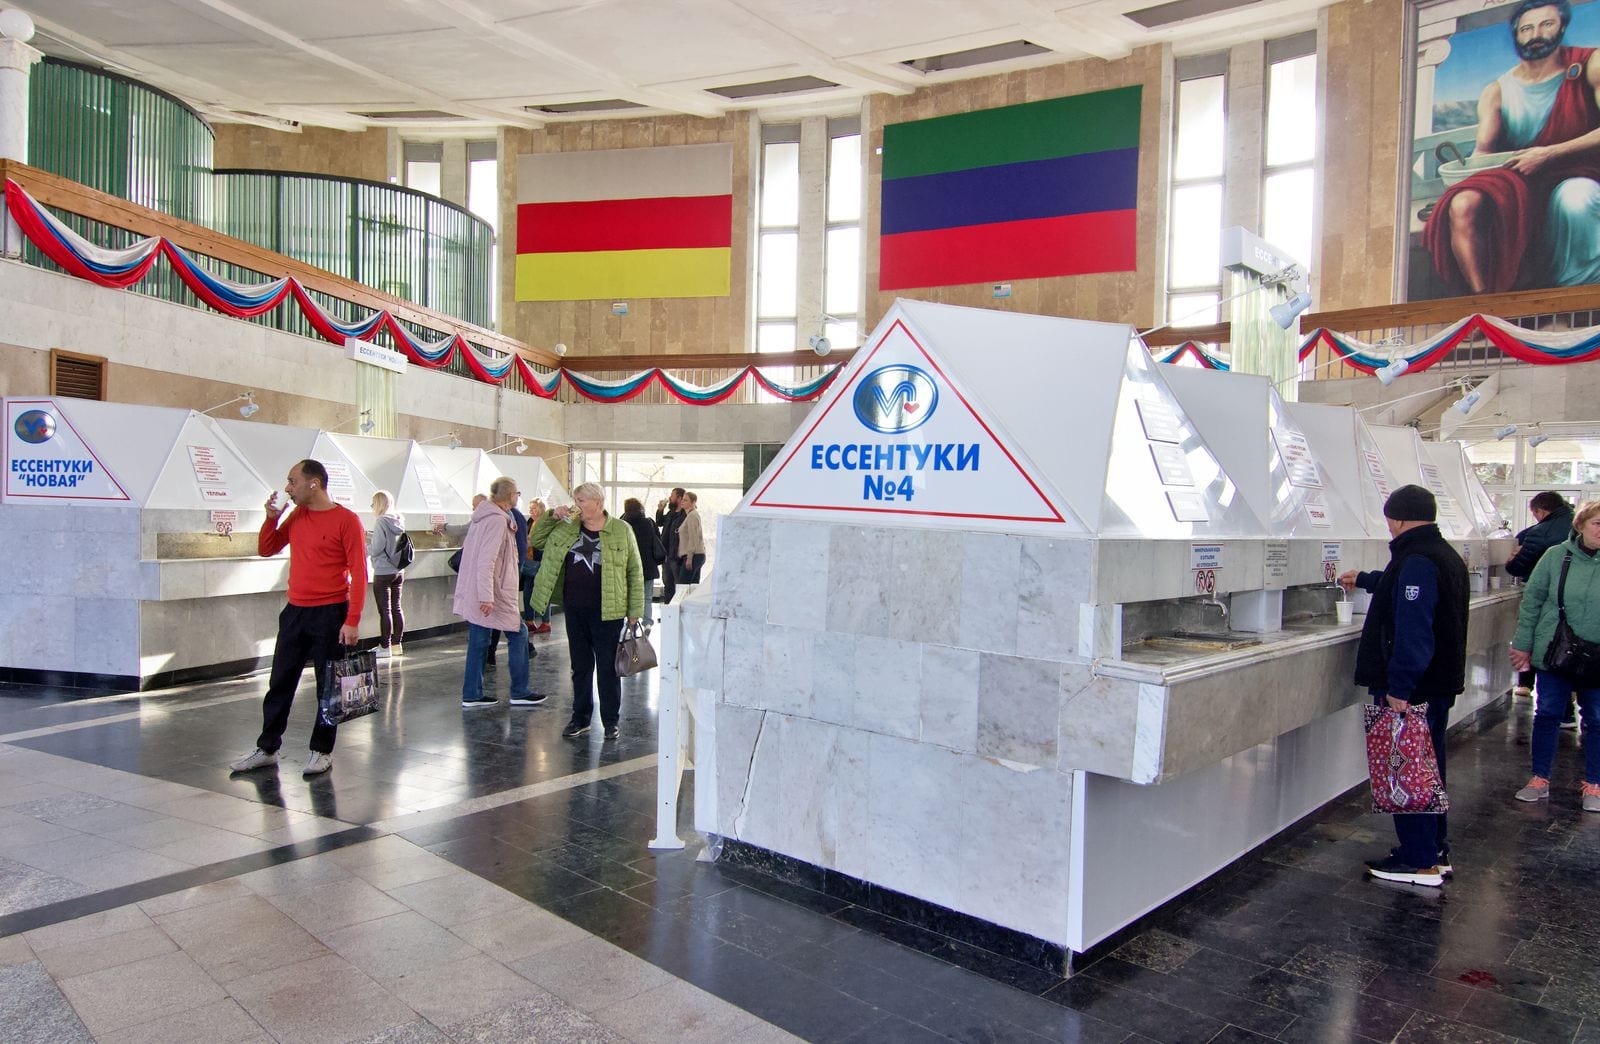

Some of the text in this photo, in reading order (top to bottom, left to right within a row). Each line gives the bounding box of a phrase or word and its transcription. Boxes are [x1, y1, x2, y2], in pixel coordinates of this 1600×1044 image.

[11, 459, 94, 474] ЕССЕНТУКИ
[811, 443, 980, 472] ЕССЕНТУКИ
[863, 475, 915, 501] №4
